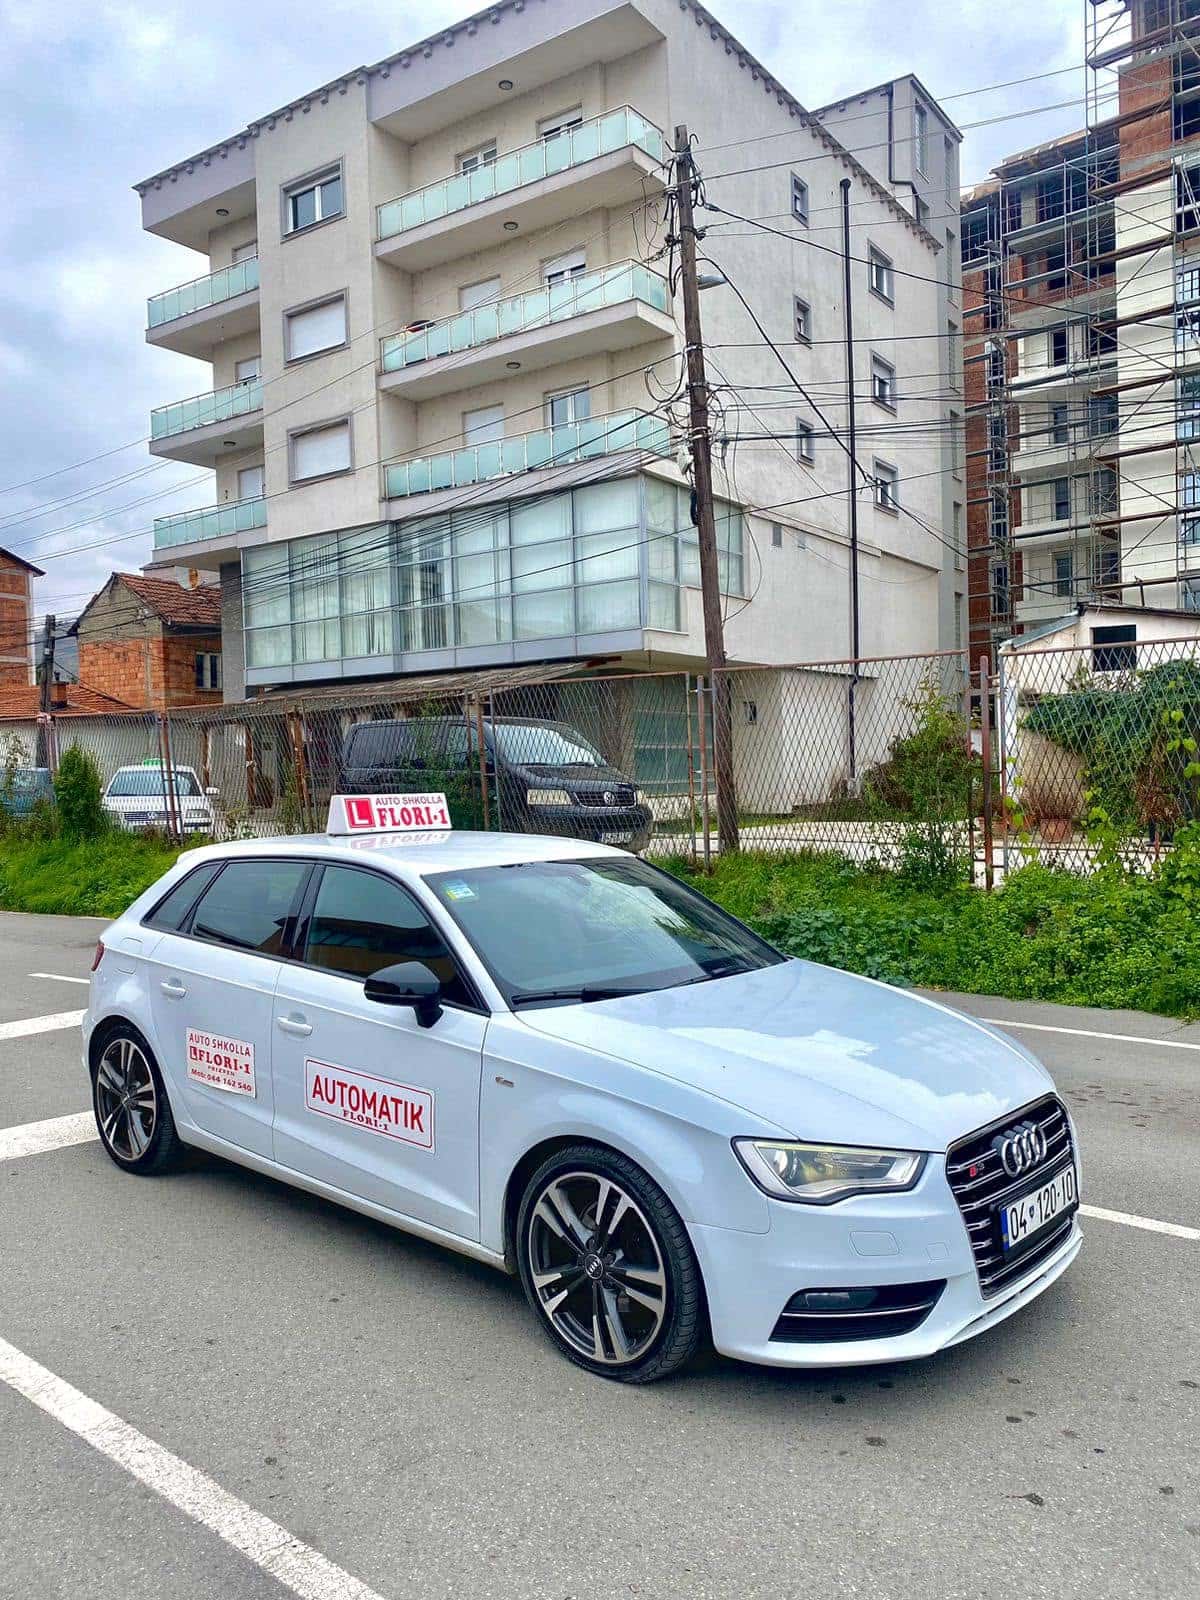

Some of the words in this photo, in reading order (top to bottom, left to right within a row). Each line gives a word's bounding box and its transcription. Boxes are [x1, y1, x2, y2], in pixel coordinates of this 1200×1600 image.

[376, 797, 400, 806] AUTO
[402, 796, 443, 805] SHKOLLA
[189, 1032, 210, 1047] AUTO
[212, 1038, 251, 1057] SHKOLLA
[312, 1075, 424, 1133] AUTOMATIK
[1010, 1202, 1028, 1241] 04
